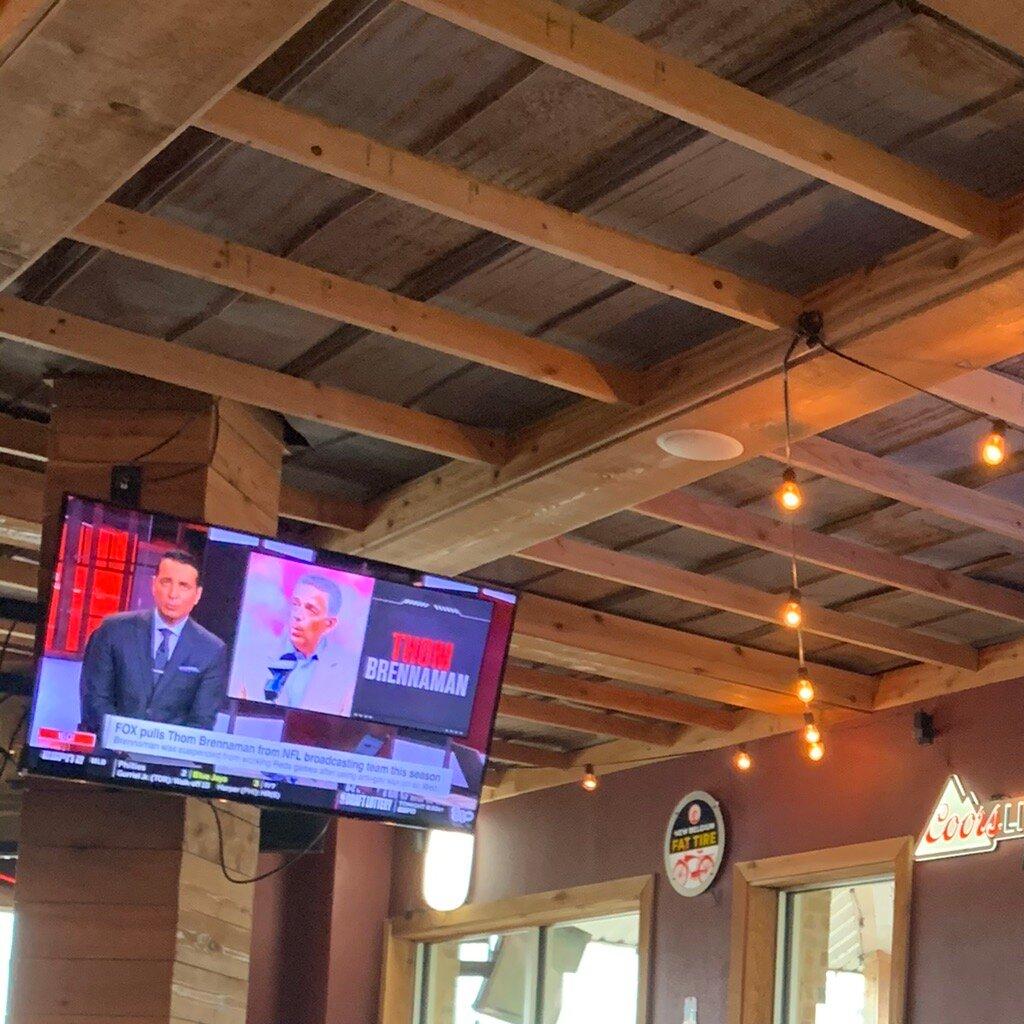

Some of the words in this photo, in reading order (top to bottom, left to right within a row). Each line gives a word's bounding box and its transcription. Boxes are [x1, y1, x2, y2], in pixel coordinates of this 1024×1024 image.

[364, 656, 470, 698] BRENNAMAN
[113, 721, 138, 736] FOX
[139, 725, 166, 741] pulls
[167, 730, 196, 744] Thom
[198, 734, 256, 754] Brennaman
[257, 743, 280, 757] from
[281, 747, 302, 761] NFL
[303, 751, 365, 772] broadcasting
[365, 762, 389, 774] team
[390, 765, 407, 777] this
[408, 769, 441, 782] season
[671, 837, 691, 853] FAT
[693, 830, 718, 849] TIRE
[925, 802, 1001, 844] Coors
